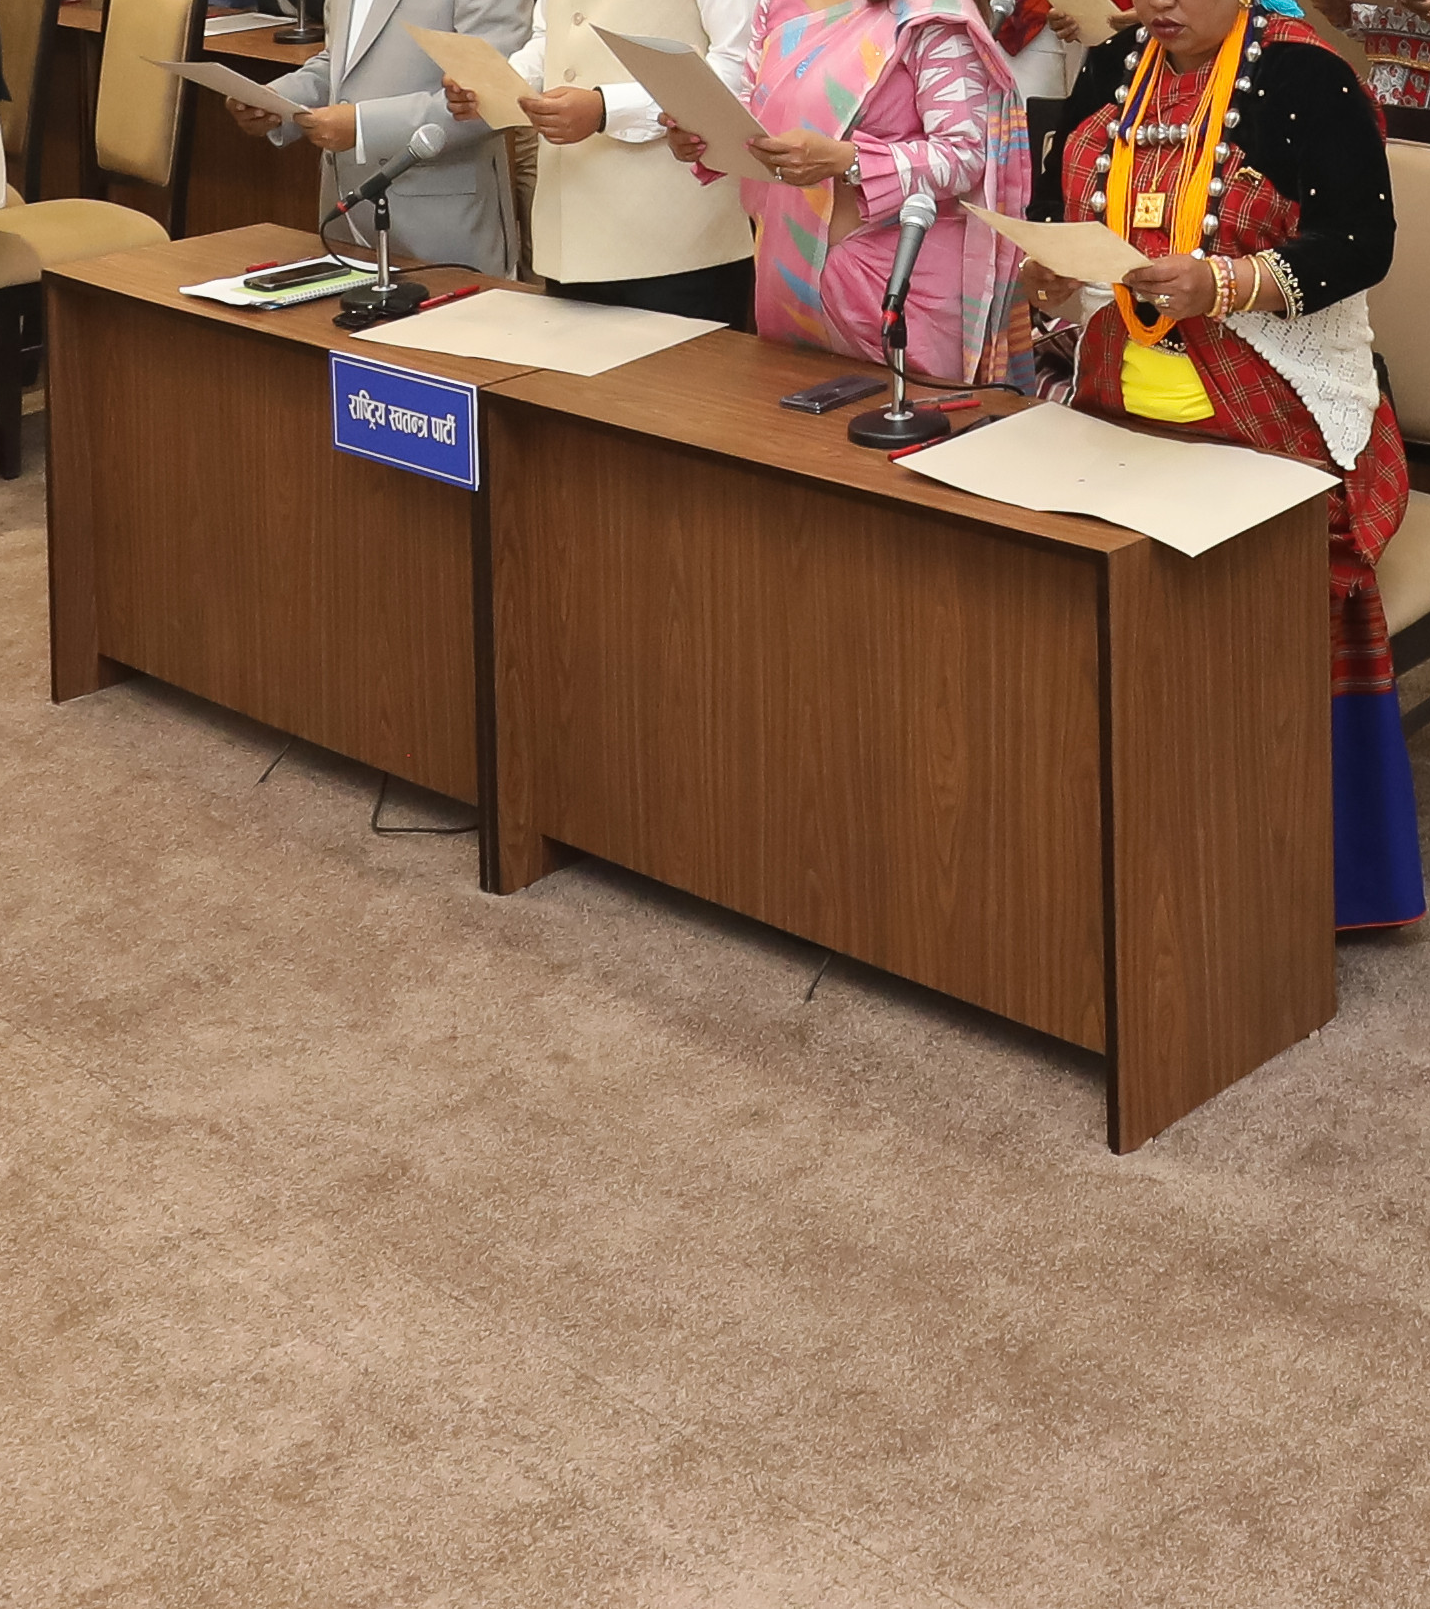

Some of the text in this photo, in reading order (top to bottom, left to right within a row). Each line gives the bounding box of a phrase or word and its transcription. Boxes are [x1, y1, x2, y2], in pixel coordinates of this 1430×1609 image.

[348, 389, 456, 445] राष्ट्रिय स्वतन्त्र पार्टी
